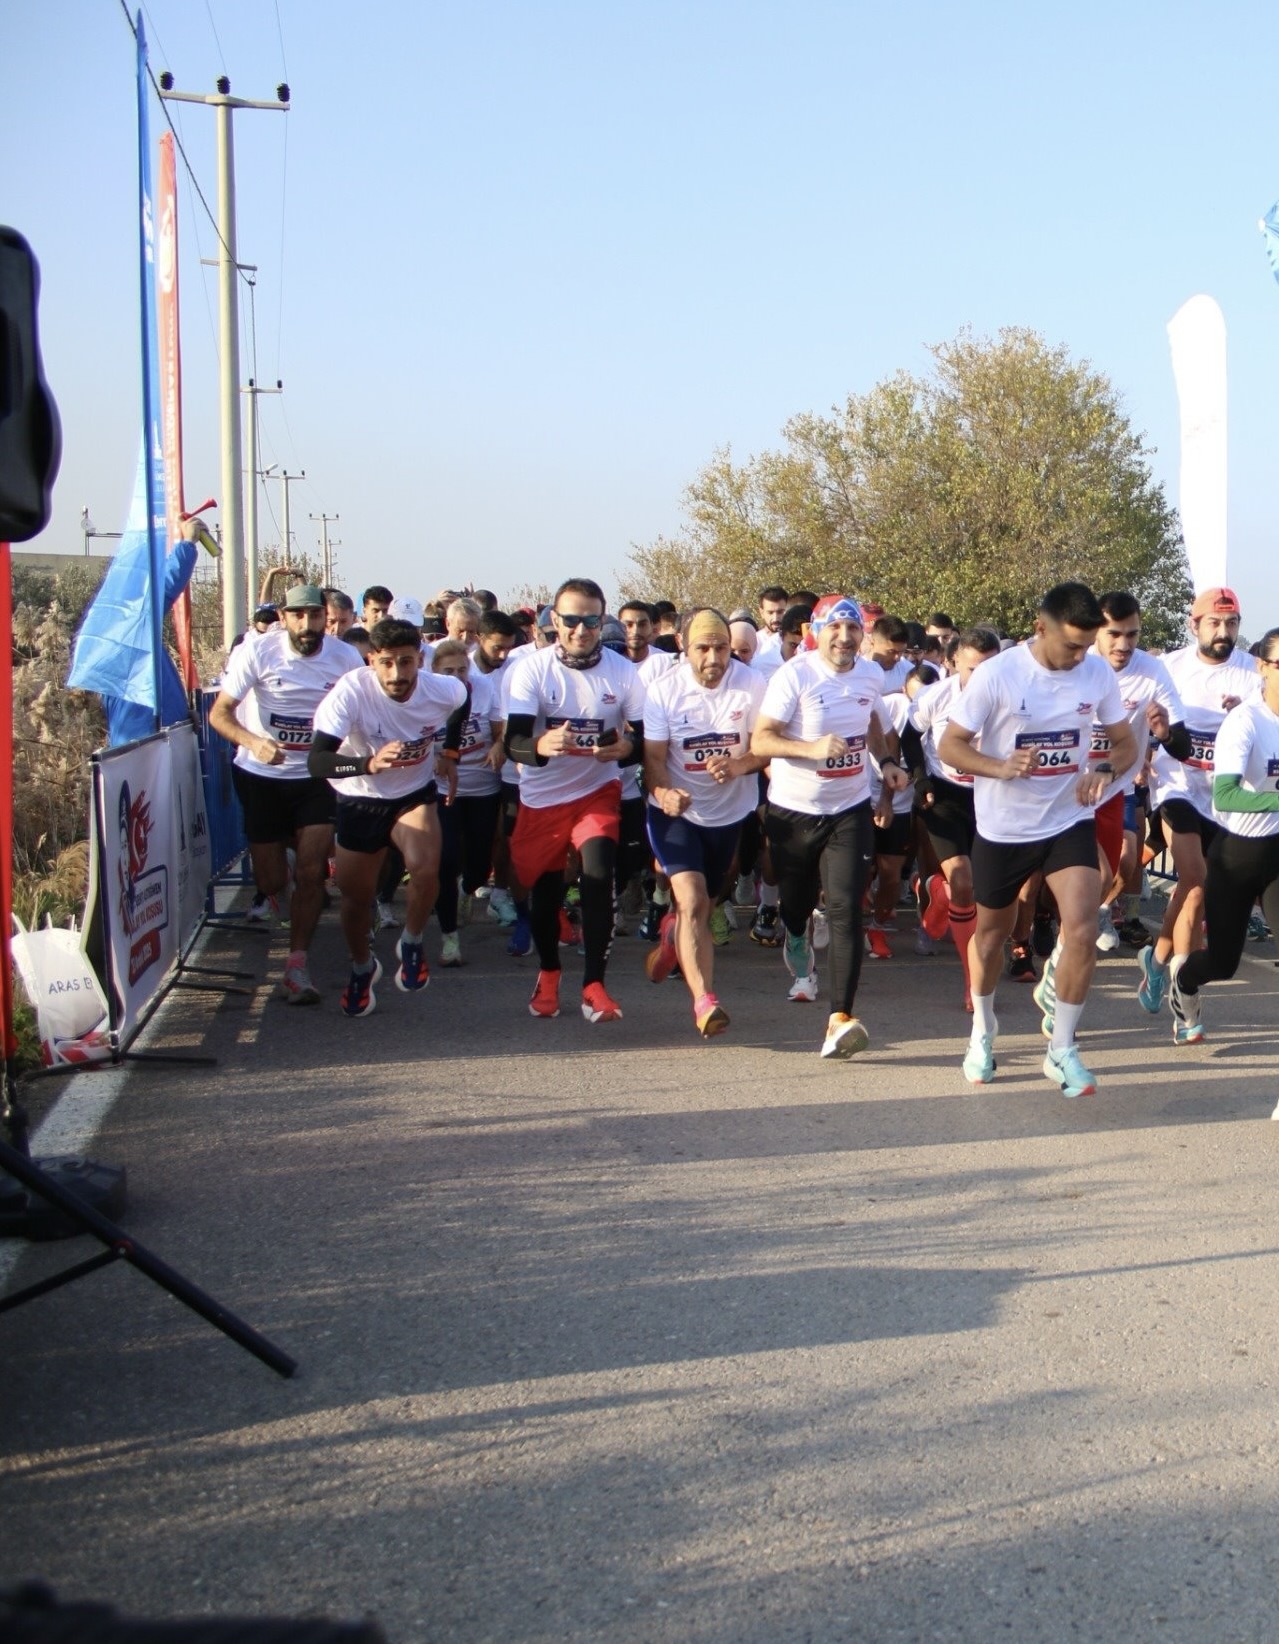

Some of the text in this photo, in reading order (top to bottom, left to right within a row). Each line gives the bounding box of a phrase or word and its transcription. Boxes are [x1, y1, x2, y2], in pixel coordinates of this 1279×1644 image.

[278, 730, 312, 743] 0172
[460, 735, 476, 748] 93
[576, 735, 595, 747] 46
[1093, 739, 1109, 750] 21
[826, 752, 862, 769] 0333
[1038, 751, 1071, 767] 064
[1190, 746, 1214, 761] 030
[49, 979, 80, 995] ARAS
